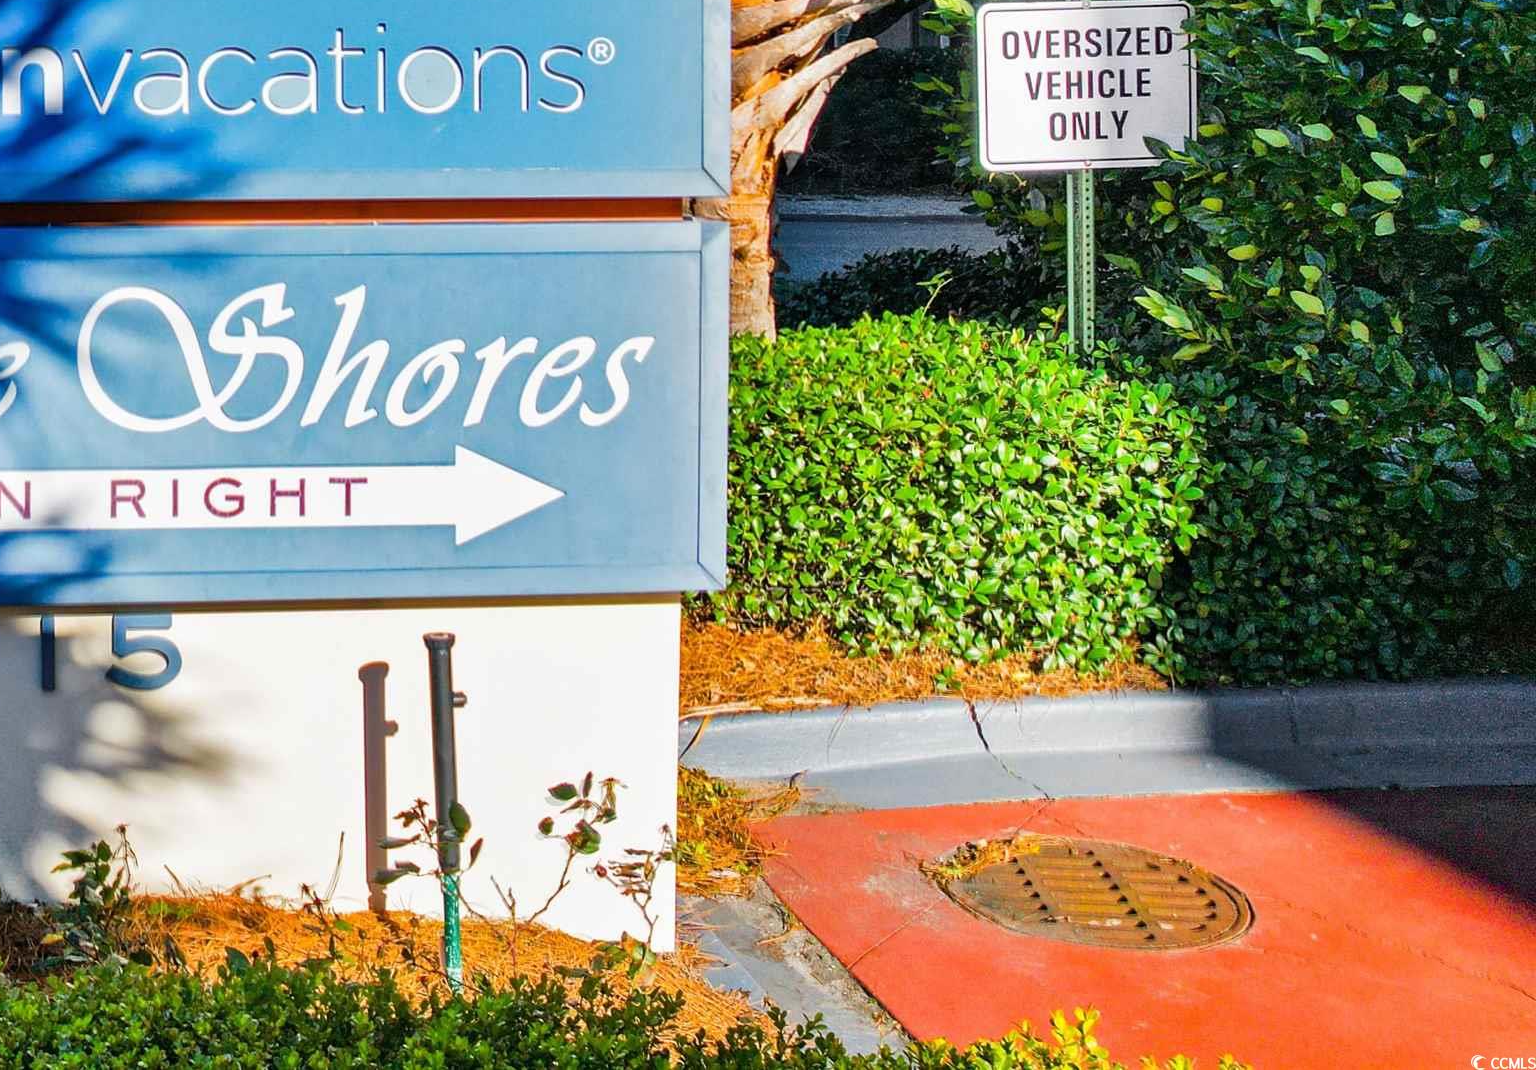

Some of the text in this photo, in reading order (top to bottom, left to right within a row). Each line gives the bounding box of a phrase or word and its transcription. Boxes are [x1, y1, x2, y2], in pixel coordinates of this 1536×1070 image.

[1001, 26, 1173, 60] OVERSIZED
[1025, 68, 1151, 100] VEHICLE
[1049, 110, 1128, 141] ONLY
[77, 282, 655, 433] Shores
[109, 477, 369, 519] RIGHT
